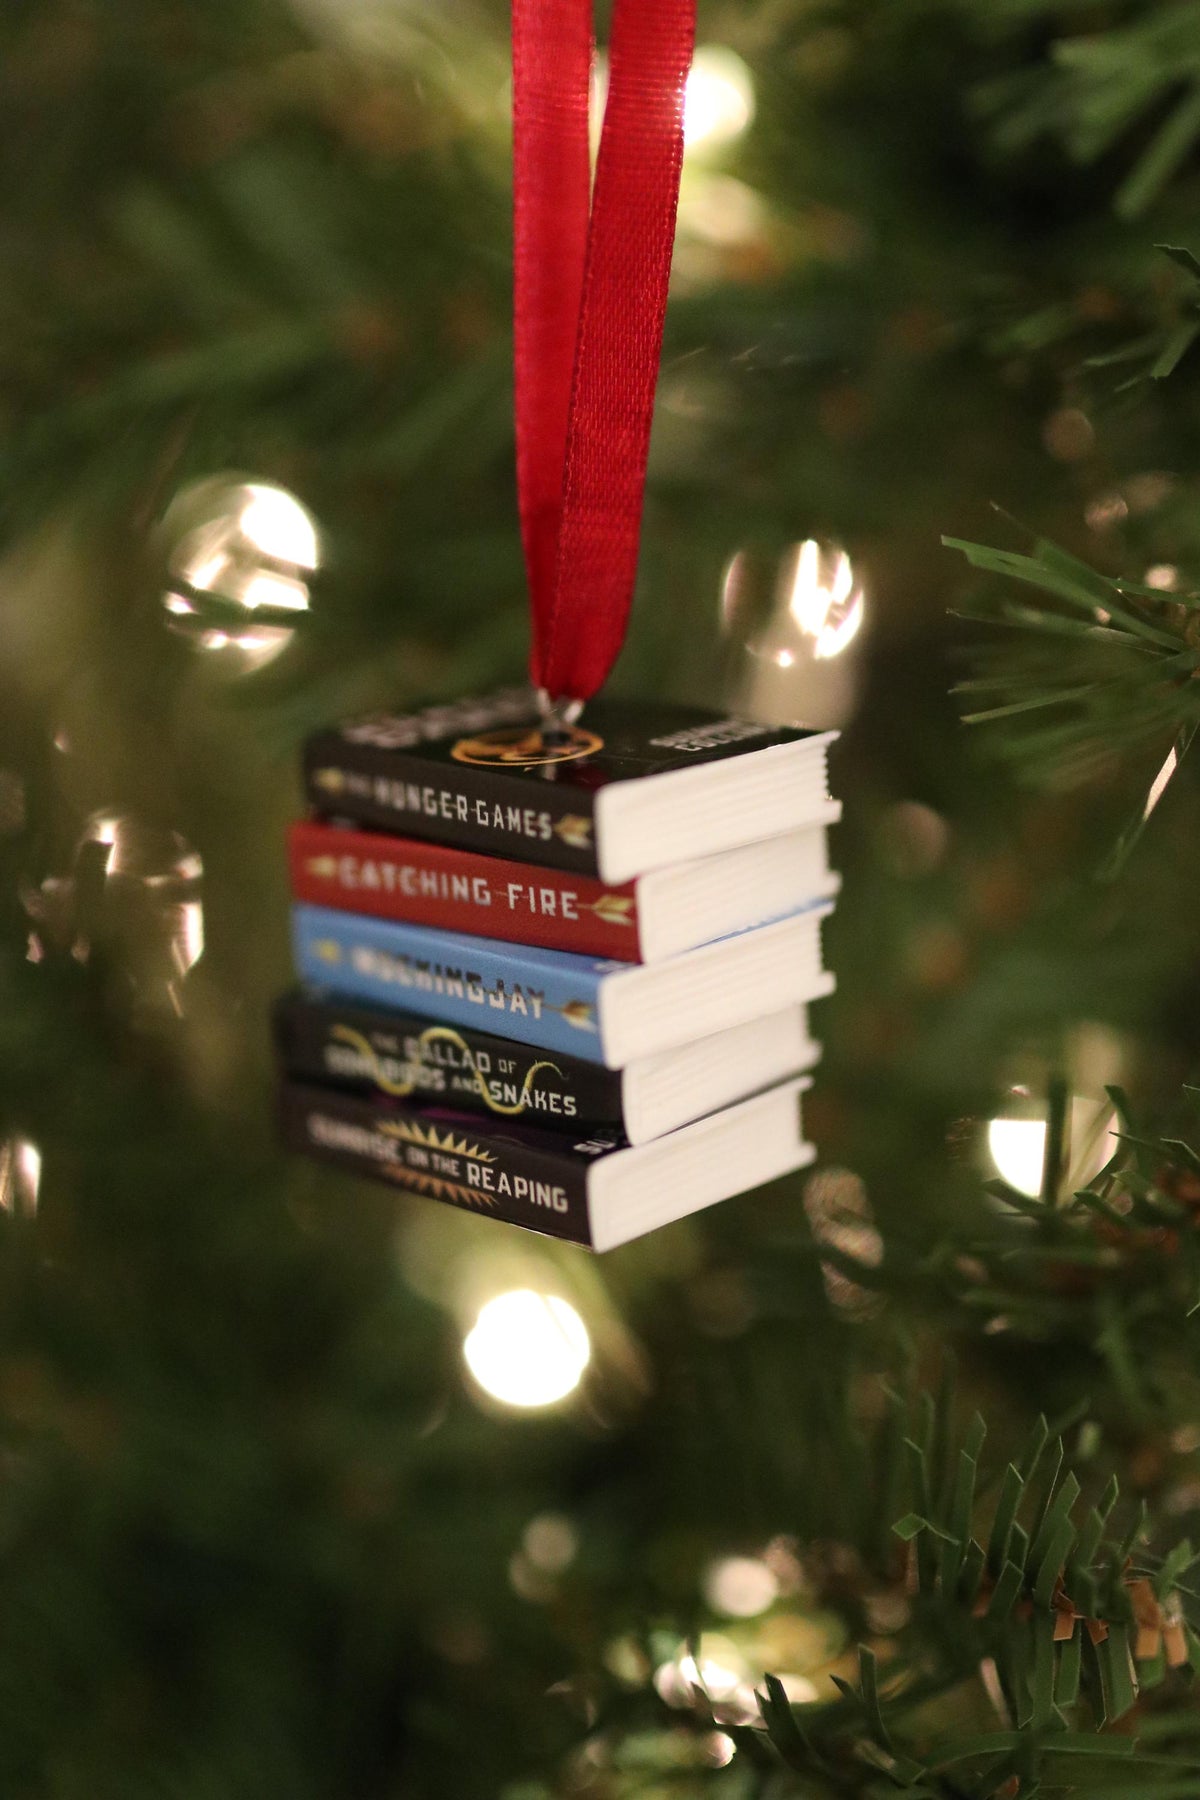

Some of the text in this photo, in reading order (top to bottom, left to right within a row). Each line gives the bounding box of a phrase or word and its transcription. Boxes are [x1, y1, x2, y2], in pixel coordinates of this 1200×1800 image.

[475, 799, 552, 841] GAMES
[338, 856, 580, 921] CATCHING FIRE
[498, 1058, 517, 1075] OF
[452, 1074, 578, 1117] AND SNAKES
[431, 1152, 462, 1178] THE
[466, 1161, 569, 1214] REAPING
